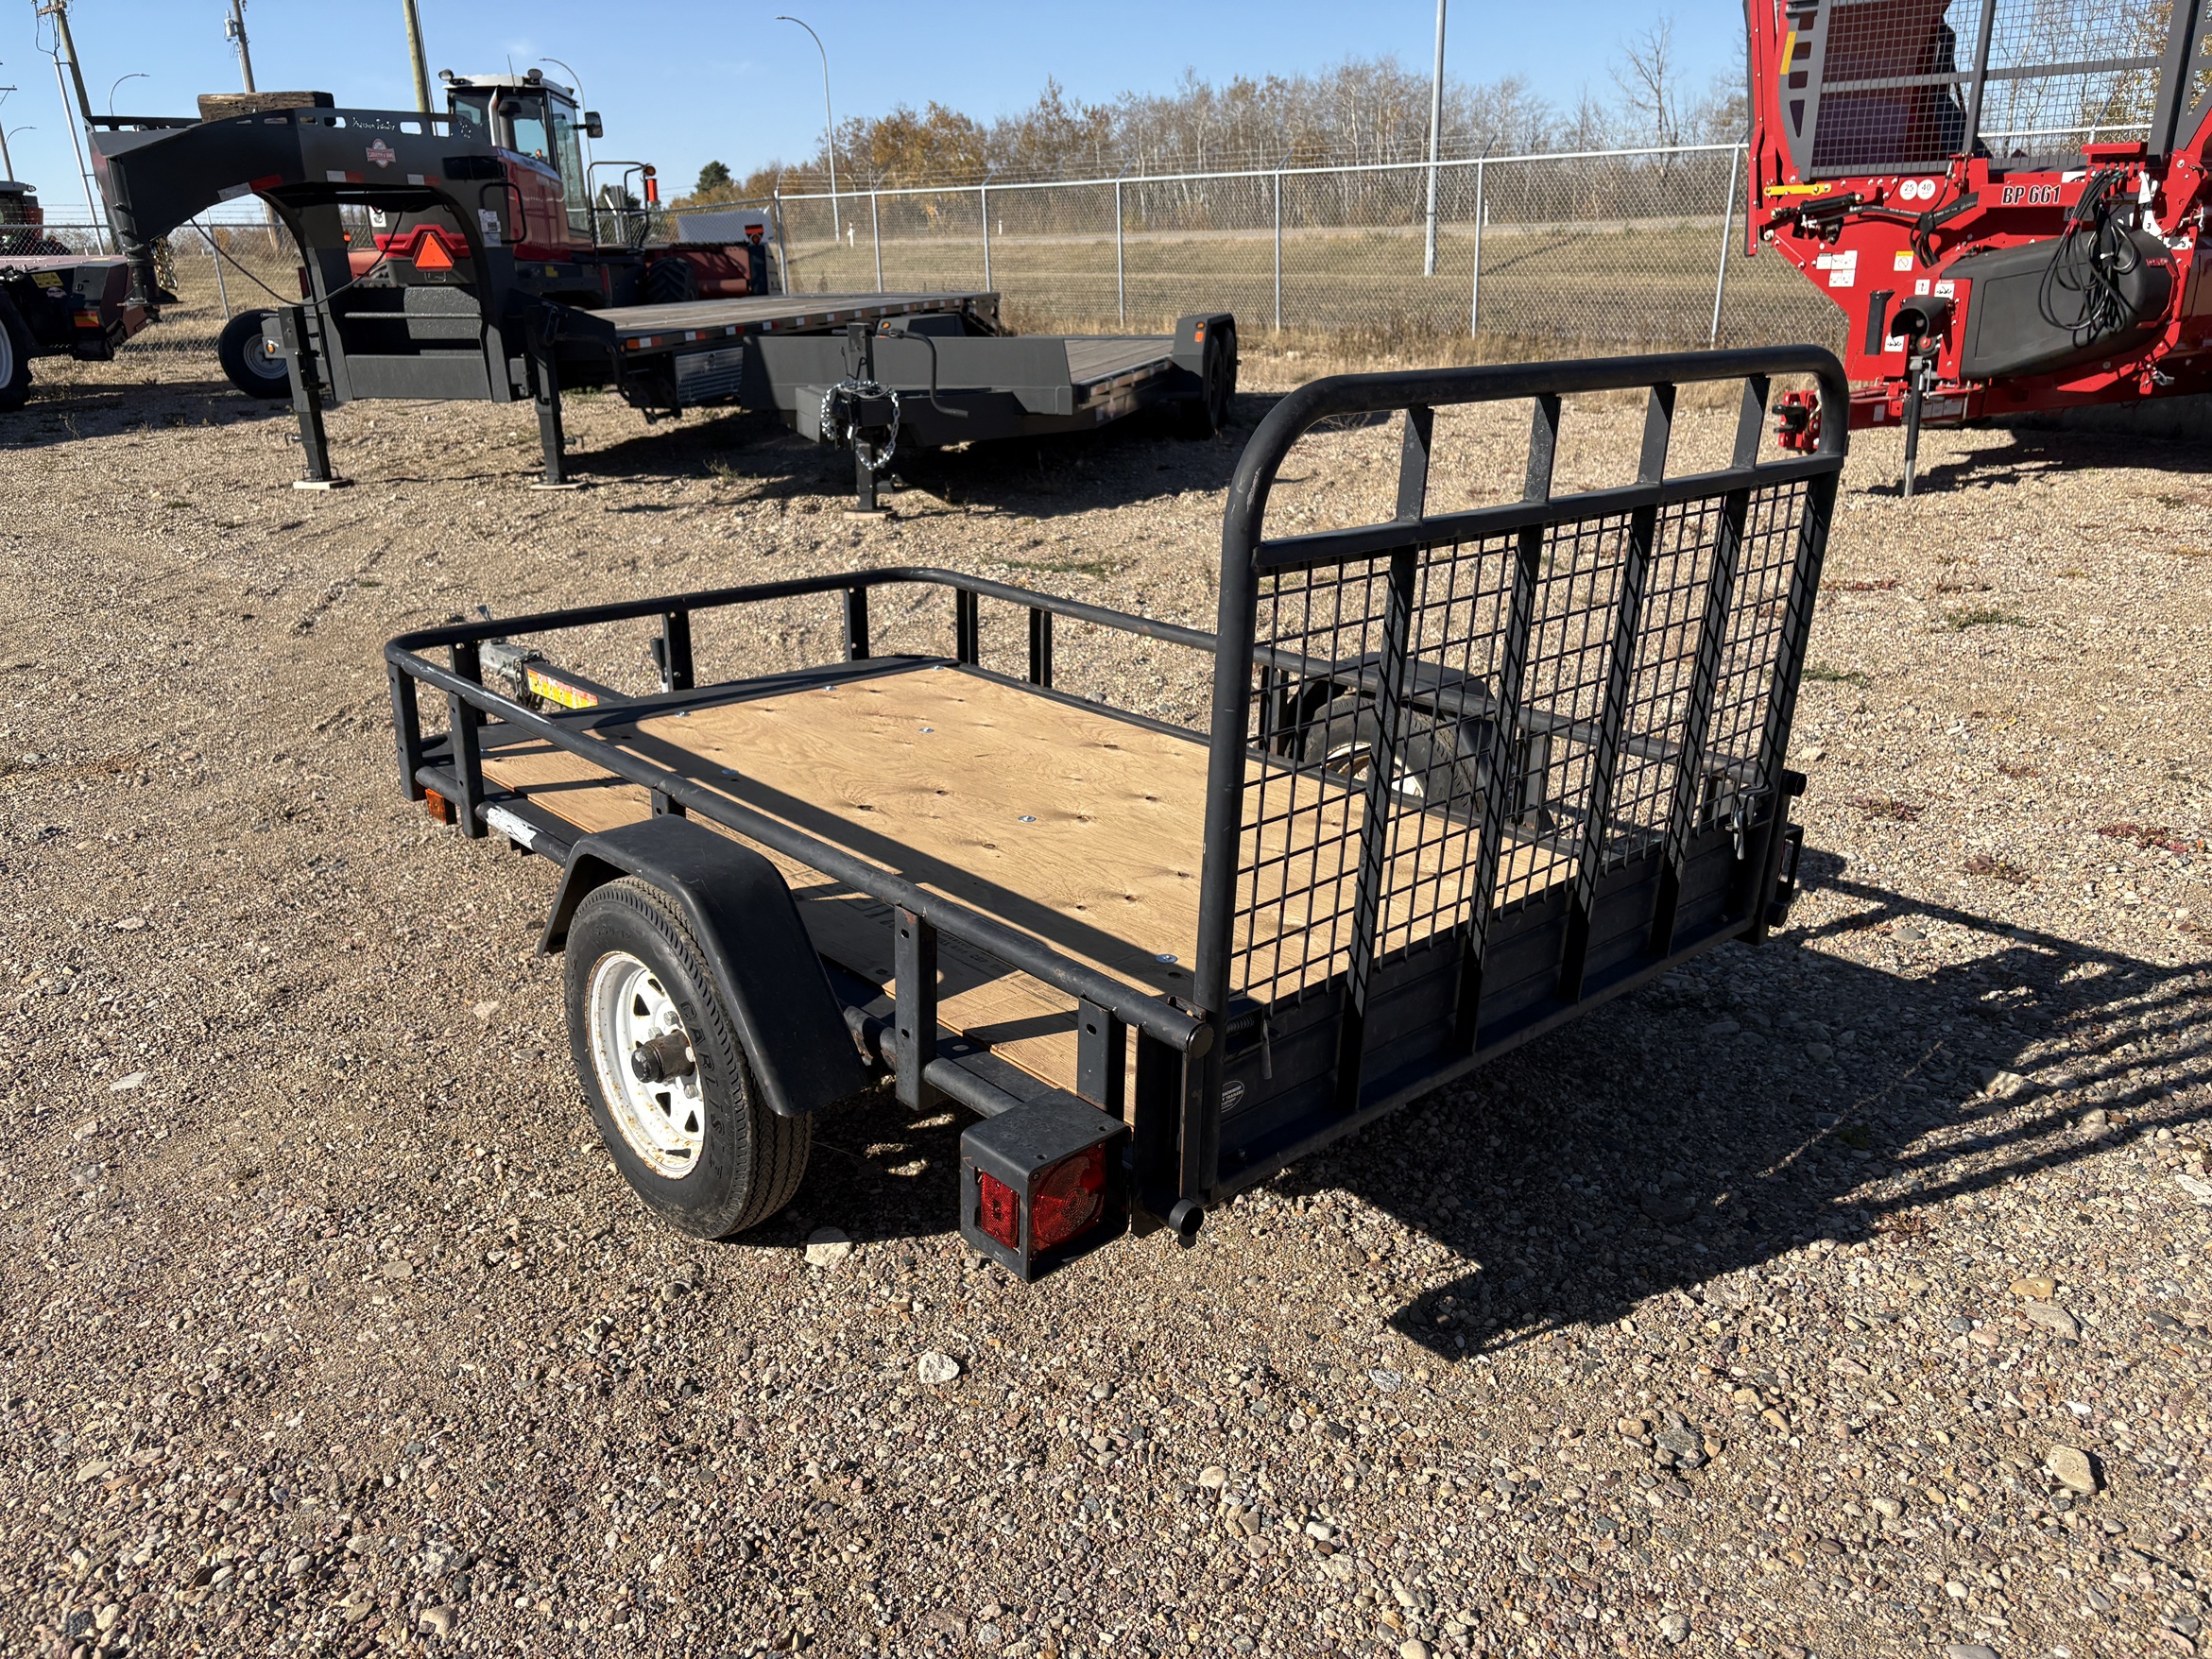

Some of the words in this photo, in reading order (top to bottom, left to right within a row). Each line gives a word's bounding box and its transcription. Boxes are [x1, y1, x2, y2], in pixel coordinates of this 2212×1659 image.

[2001, 186, 2025, 205] BP
[2028, 184, 2061, 204] 661
[679, 1001, 725, 1179] CARLISLE
